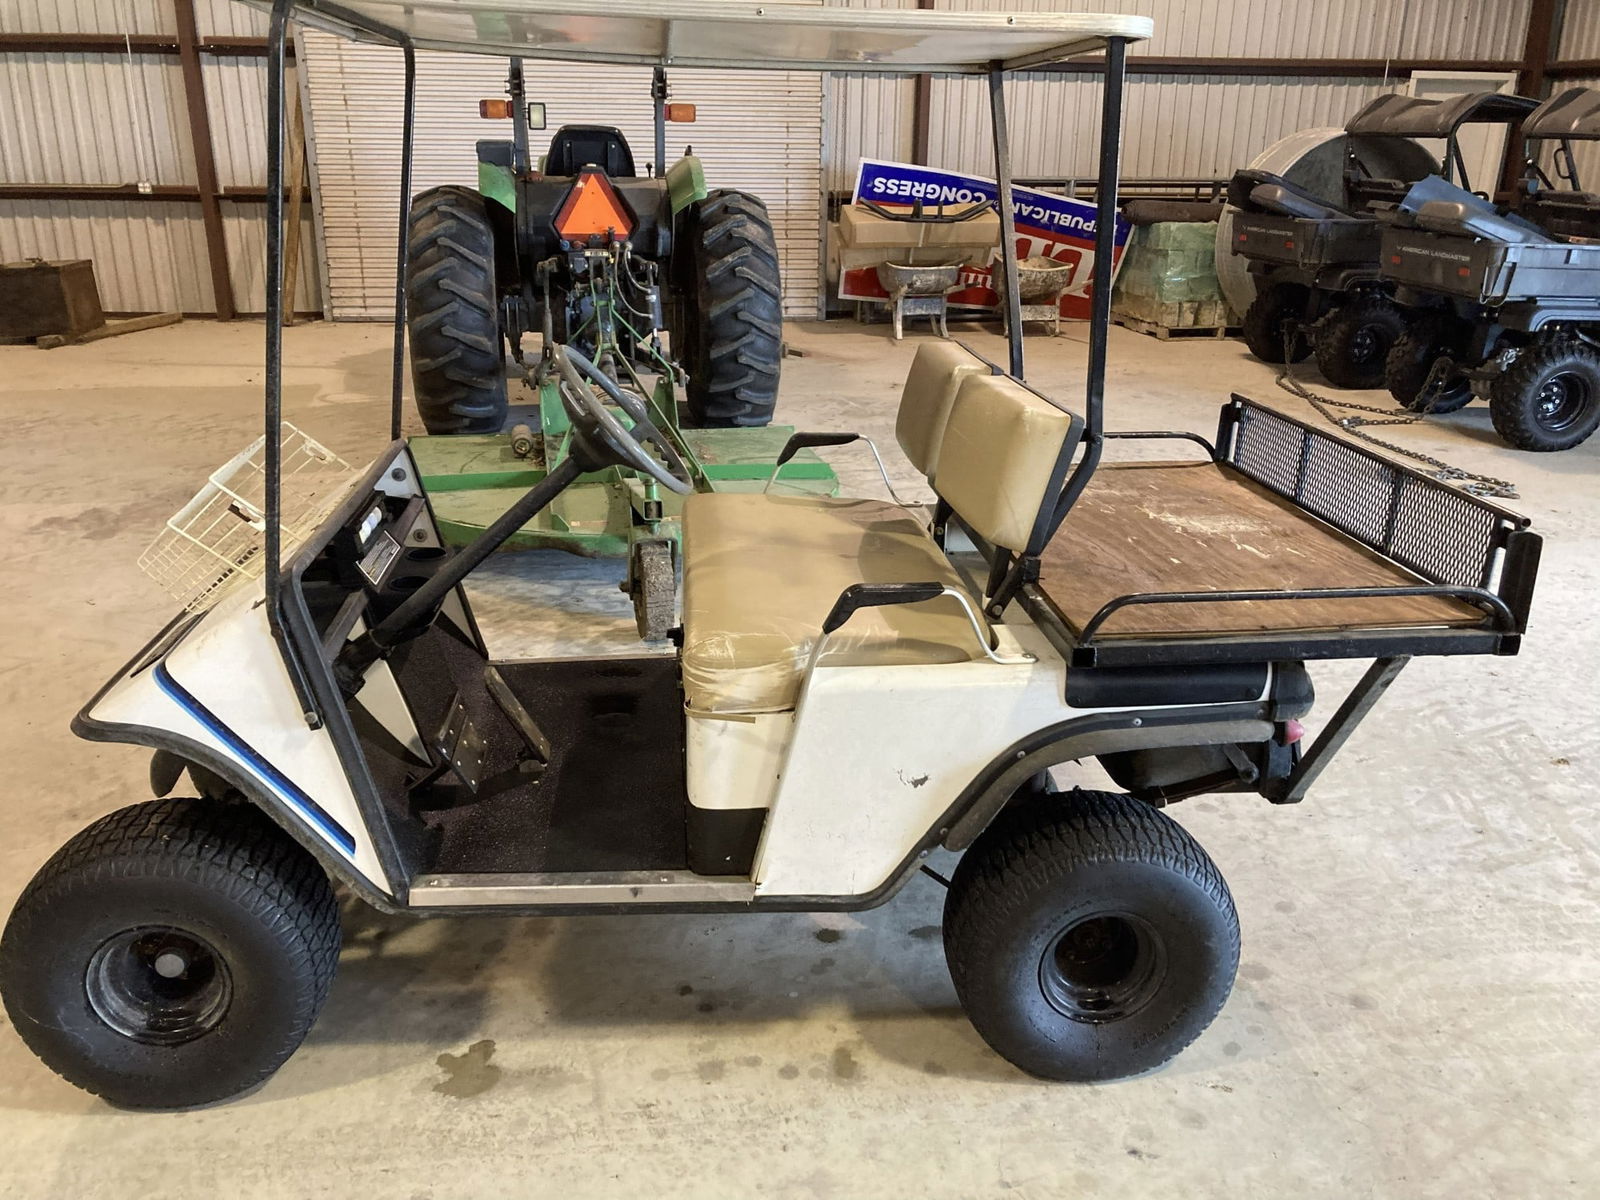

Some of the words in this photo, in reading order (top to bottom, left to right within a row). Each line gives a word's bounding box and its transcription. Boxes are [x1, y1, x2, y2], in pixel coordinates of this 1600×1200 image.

[873, 176, 987, 205] CONGRESS
[1402, 246, 1430, 256] AMERICAN
[1430, 250, 1470, 262] LANDMASTER
